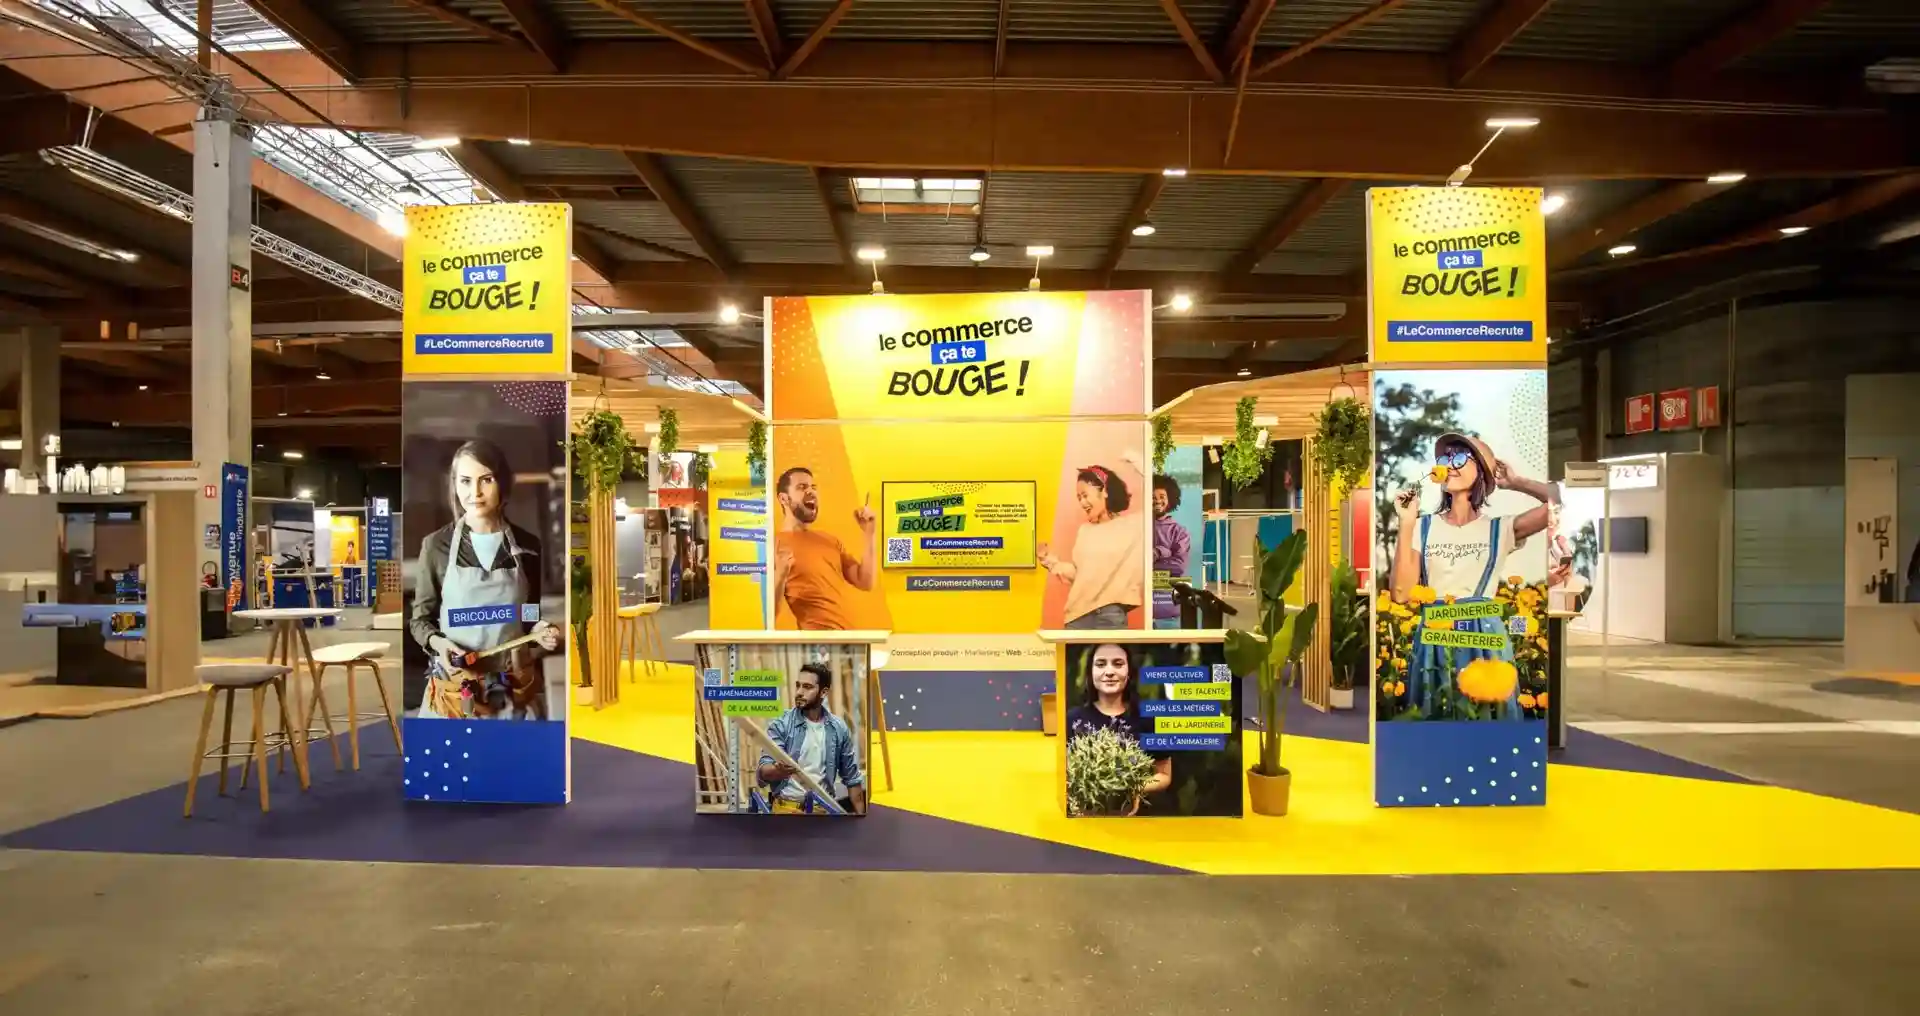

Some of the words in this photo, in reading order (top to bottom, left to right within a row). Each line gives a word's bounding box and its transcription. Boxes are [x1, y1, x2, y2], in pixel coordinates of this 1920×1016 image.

[1393, 243, 1408, 257] le
[1413, 231, 1520, 255] commerce
[423, 259, 436, 273] le
[440, 246, 543, 271] commerce
[1444, 256, 1459, 268] ça
[1462, 254, 1475, 265] te
[232, 269, 249, 286] B4
[469, 271, 484, 284] ça
[486, 269, 498, 281] te
[1401, 267, 1501, 296] BOUGE
[429, 281, 523, 310] BOUGE
[879, 334, 896, 351] le
[902, 317, 1032, 348] commerce
[1397, 325, 1524, 336] #LeCommerceRecrute
[424, 338, 544, 349] #LeCommerceRecrute
[939, 348, 957, 364] ça
[961, 345, 976, 359] te
[888, 360, 1008, 396] BOUGE
[907, 495, 963, 510] commerce
[902, 516, 953, 531] BOUGE
[926, 539, 999, 547] #LeCommerceRecrute
[913, 579, 1004, 588] #LeCommerceRecrute
[453, 609, 512, 622] BRICOLAGE
[1429, 604, 1500, 620] JARDINERIES
[1457, 621, 1472, 630] ET
[1424, 632, 1503, 647] GRAINETERIES
[891, 649, 931, 657] Conception
[932, 649, 958, 657] produit
[1145, 671, 1167, 679] VIENS
[1169, 671, 1204, 679] CULTIVER
[728, 704, 737, 712] DE
[740, 704, 748, 712] LA
[751, 704, 778, 712] MAISON
[1145, 704, 1166, 712] DANS
[1168, 704, 1182, 712] LES
[1184, 703, 1215, 712] MÉTIERS
